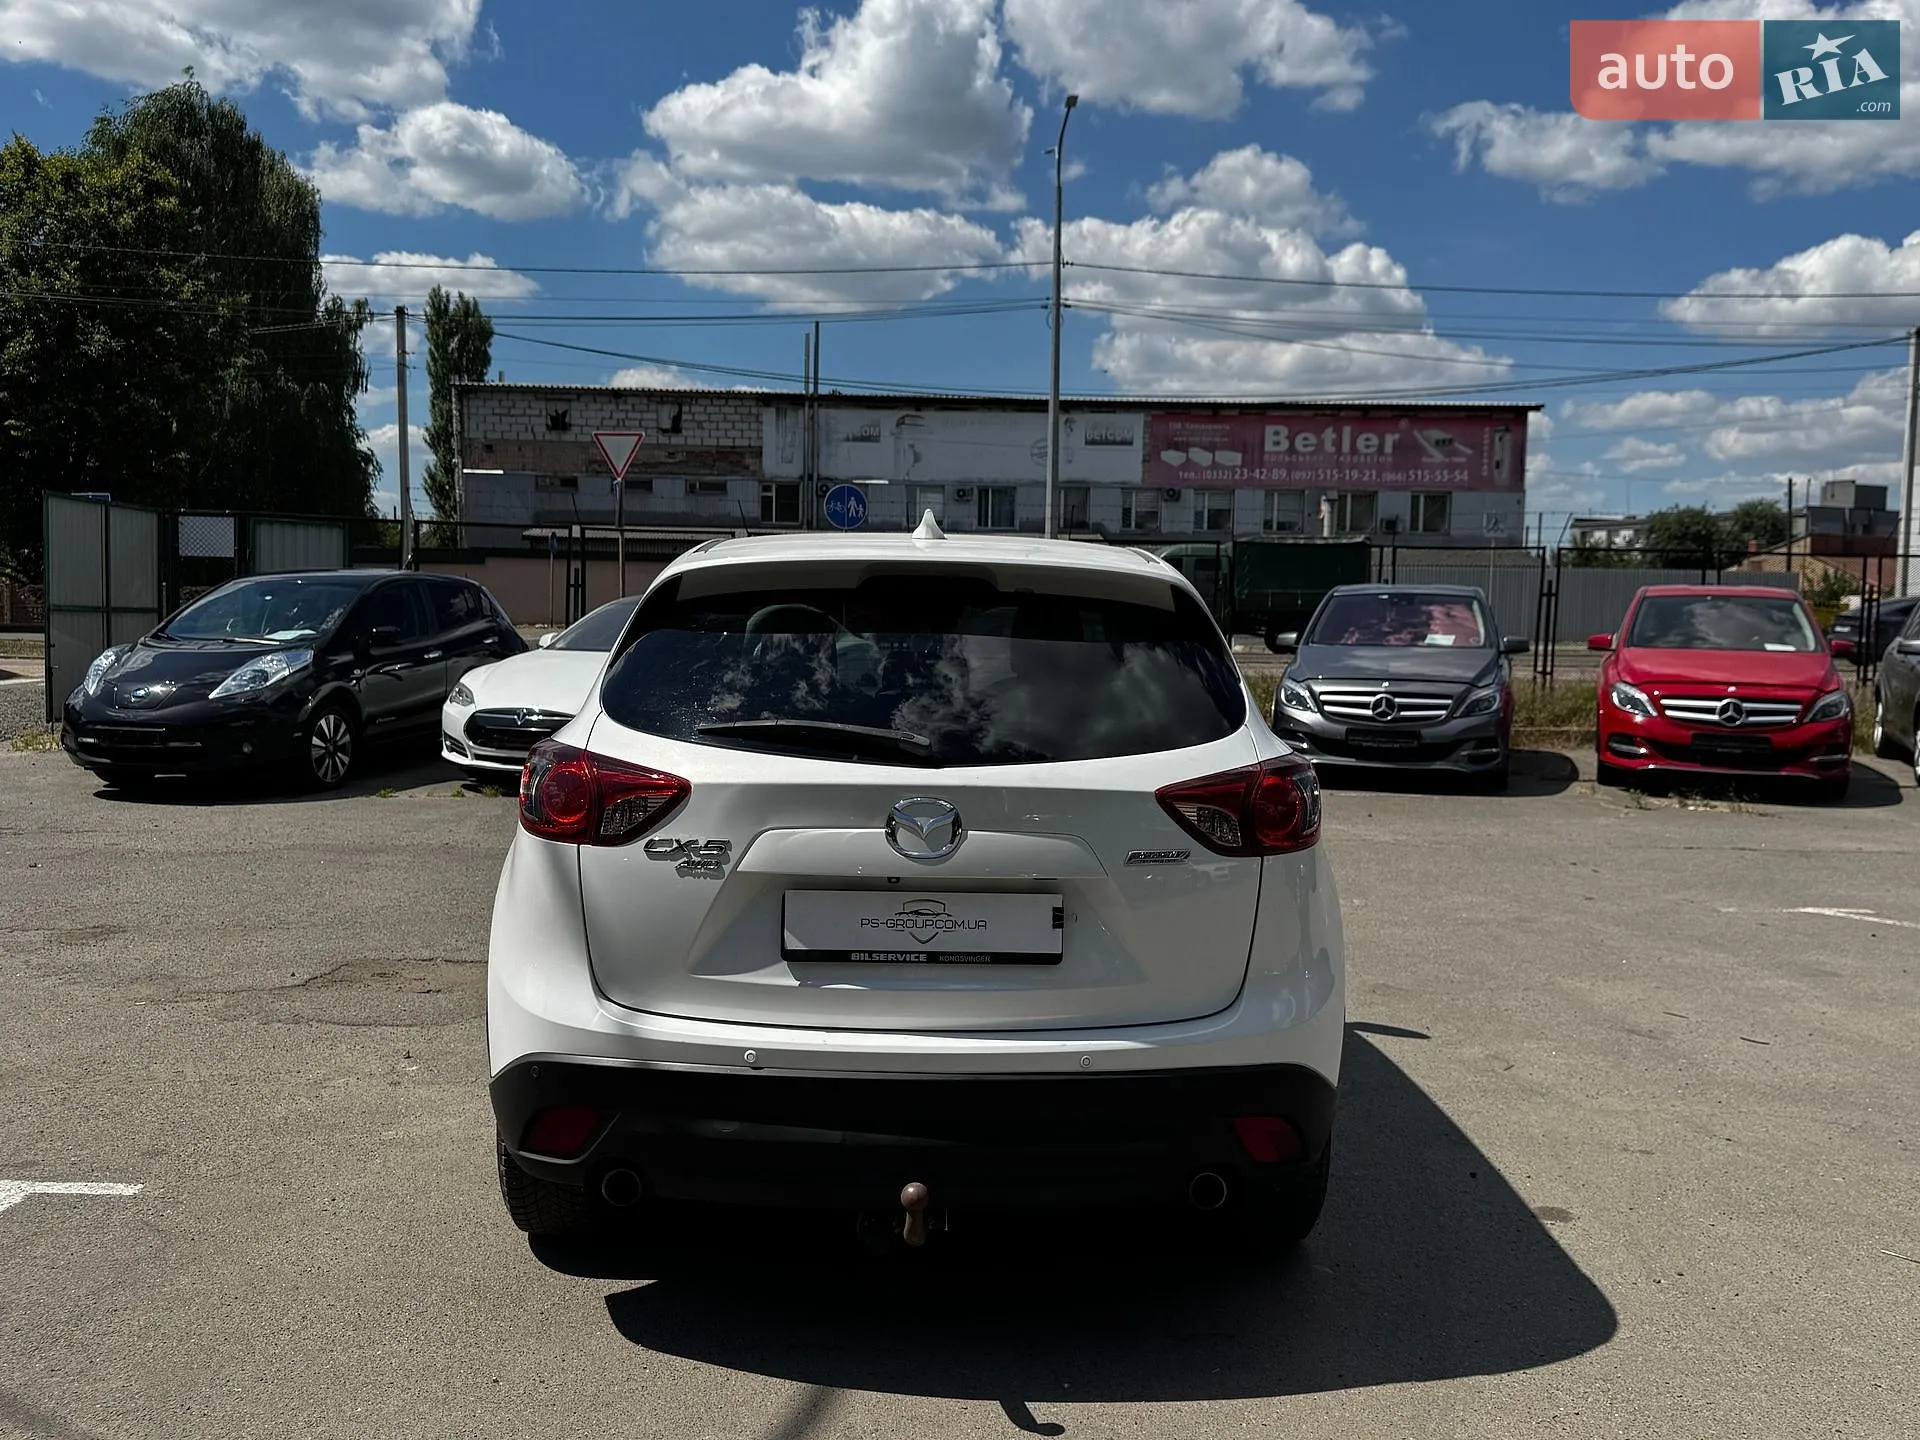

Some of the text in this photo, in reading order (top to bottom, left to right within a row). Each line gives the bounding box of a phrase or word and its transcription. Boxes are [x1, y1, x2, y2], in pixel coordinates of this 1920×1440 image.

[1263, 424, 1400, 454] Betler
[1234, 467, 1290, 481] 23-42-89,
[1317, 468, 1381, 482] 515-19-21,
[1408, 468, 1469, 483] 515-55-54
[643, 838, 731, 859] CX-5
[851, 952, 991, 964] BILSERVICE KONGSVINGER
